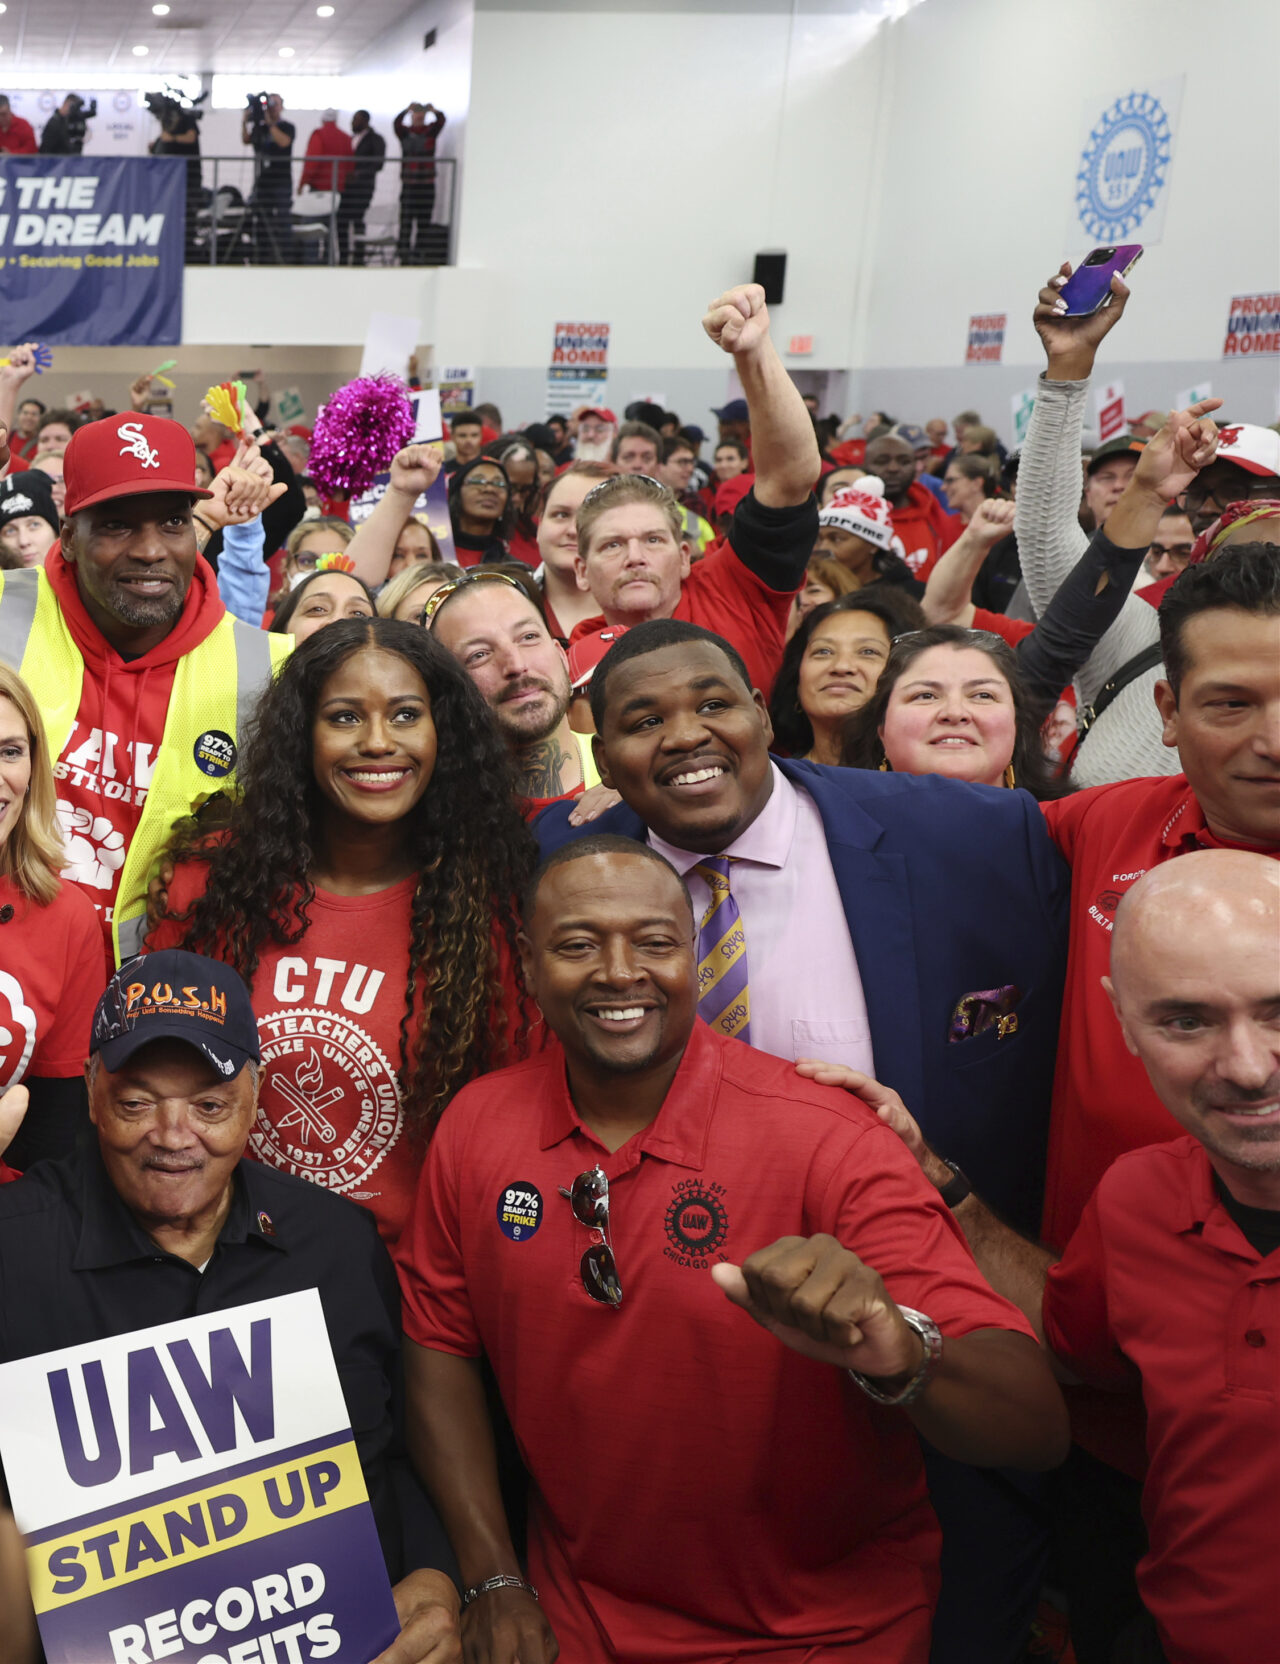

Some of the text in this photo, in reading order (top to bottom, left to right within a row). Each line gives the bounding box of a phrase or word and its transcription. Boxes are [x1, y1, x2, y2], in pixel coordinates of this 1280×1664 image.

[15, 176, 99, 209] THE
[13, 213, 165, 246] DREAM
[20, 254, 82, 270] Securing
[85, 254, 123, 267] Good
[126, 254, 160, 267] Jobs
[555, 322, 610, 338] PROUD
[819, 514, 884, 540] upreme
[200, 745, 231, 762] READY TO
[203, 734, 233, 756] 97%
[198, 751, 229, 769] STRIKE
[53, 761, 150, 807] STRON
[1088, 905, 1109, 927] BUILT
[273, 957, 386, 1015] CTU
[158, 1007, 195, 1017] Something
[261, 1039, 304, 1066] NIZE
[322, 1043, 368, 1092] UNITE
[268, 1017, 397, 1148] TEACHERS UNION
[332, 1099, 374, 1162] DEFEND
[251, 1132, 286, 1168] AFT
[286, 1144, 323, 1165] 1937
[505, 1190, 538, 1209] 97%
[672, 1179, 727, 1196] LOCAL 551
[502, 1213, 536, 1227] STRIKE
[503, 1205, 537, 1217] READY TO
[683, 1213, 709, 1230] UAW
[664, 1247, 709, 1269] CHICAGO
[47, 1317, 275, 1487] UAW
[48, 1461, 341, 1595] STAND UP
[109, 1563, 326, 1664] RECORD
[195, 1613, 341, 1664] FITS
